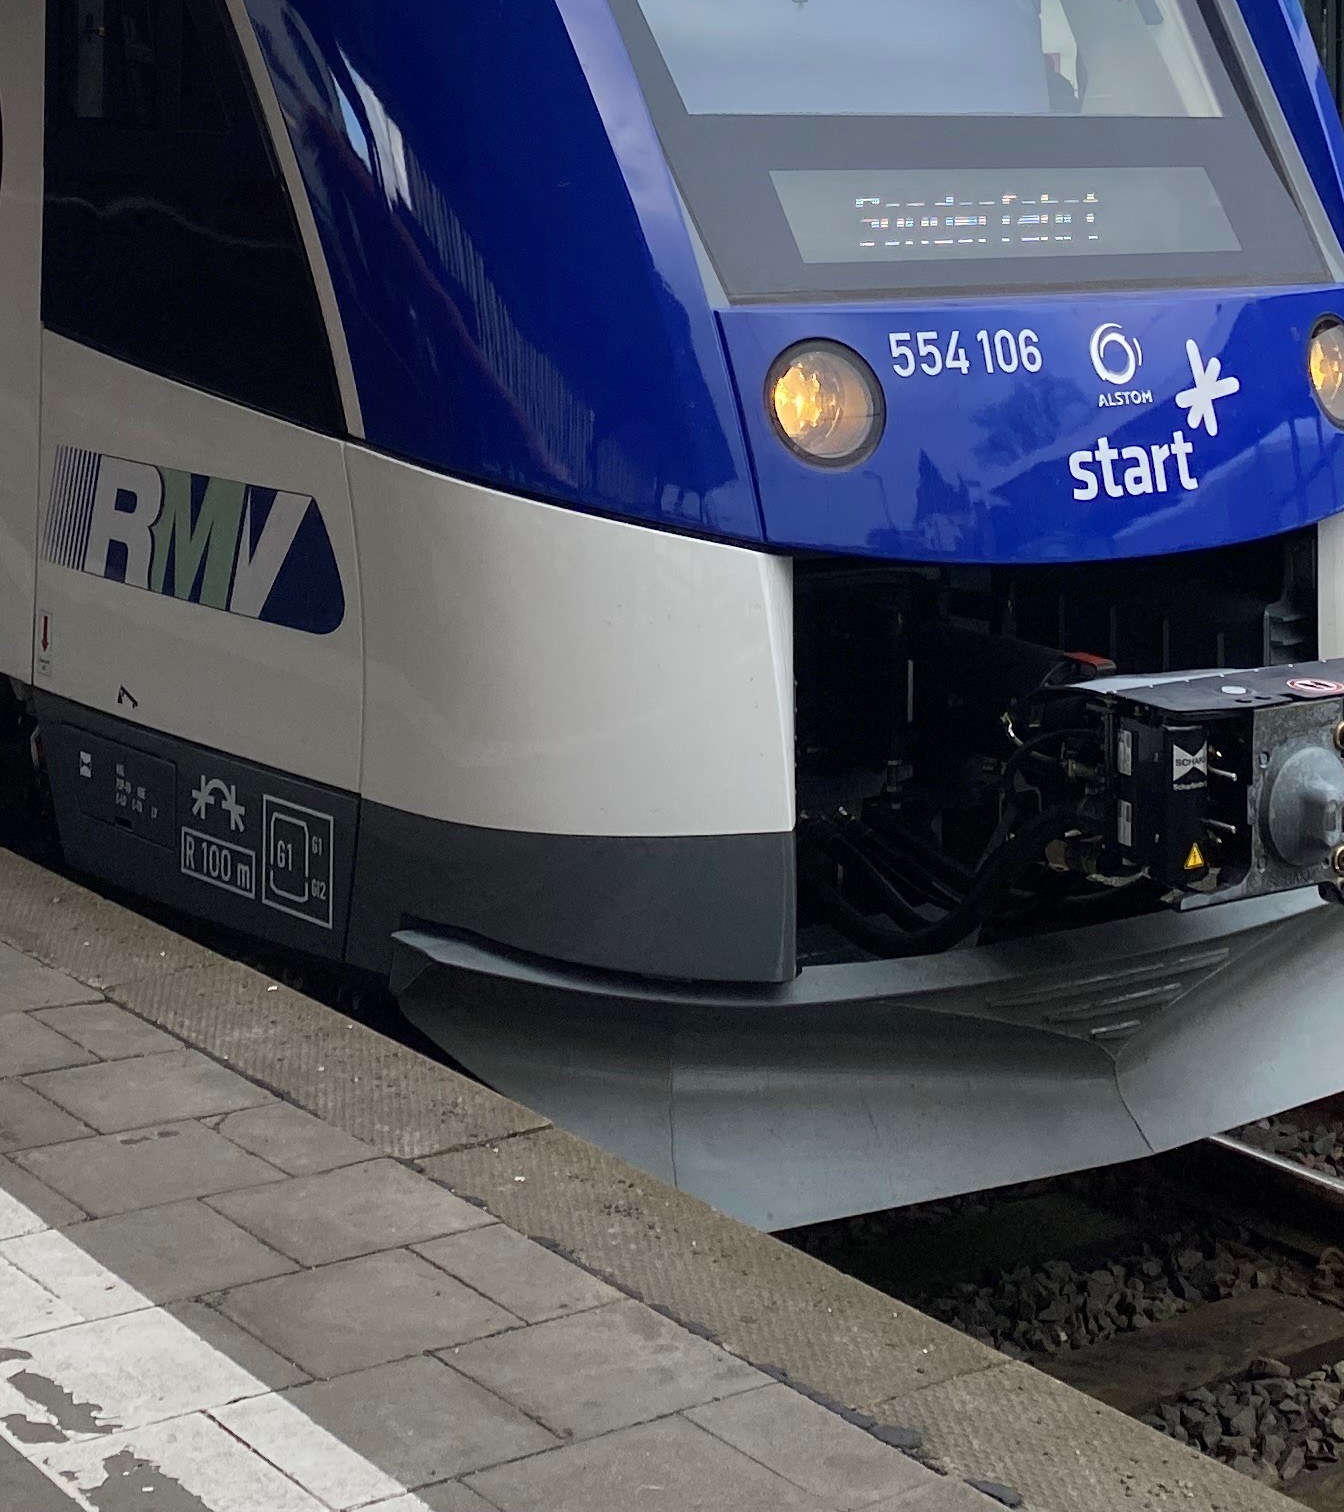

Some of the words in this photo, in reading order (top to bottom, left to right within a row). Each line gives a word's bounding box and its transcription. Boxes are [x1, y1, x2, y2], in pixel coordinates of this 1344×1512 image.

[888, 330, 970, 377] 554
[976, 328, 1043, 373] 106
[1098, 390, 1153, 407] ALSTOM
[1068, 430, 1199, 501] start
[84, 453, 313, 619] RMV
[186, 835, 195, 869] R
[202, 839, 231, 882] 100
[237, 862, 250, 890] m
[277, 840, 292, 871] G1
